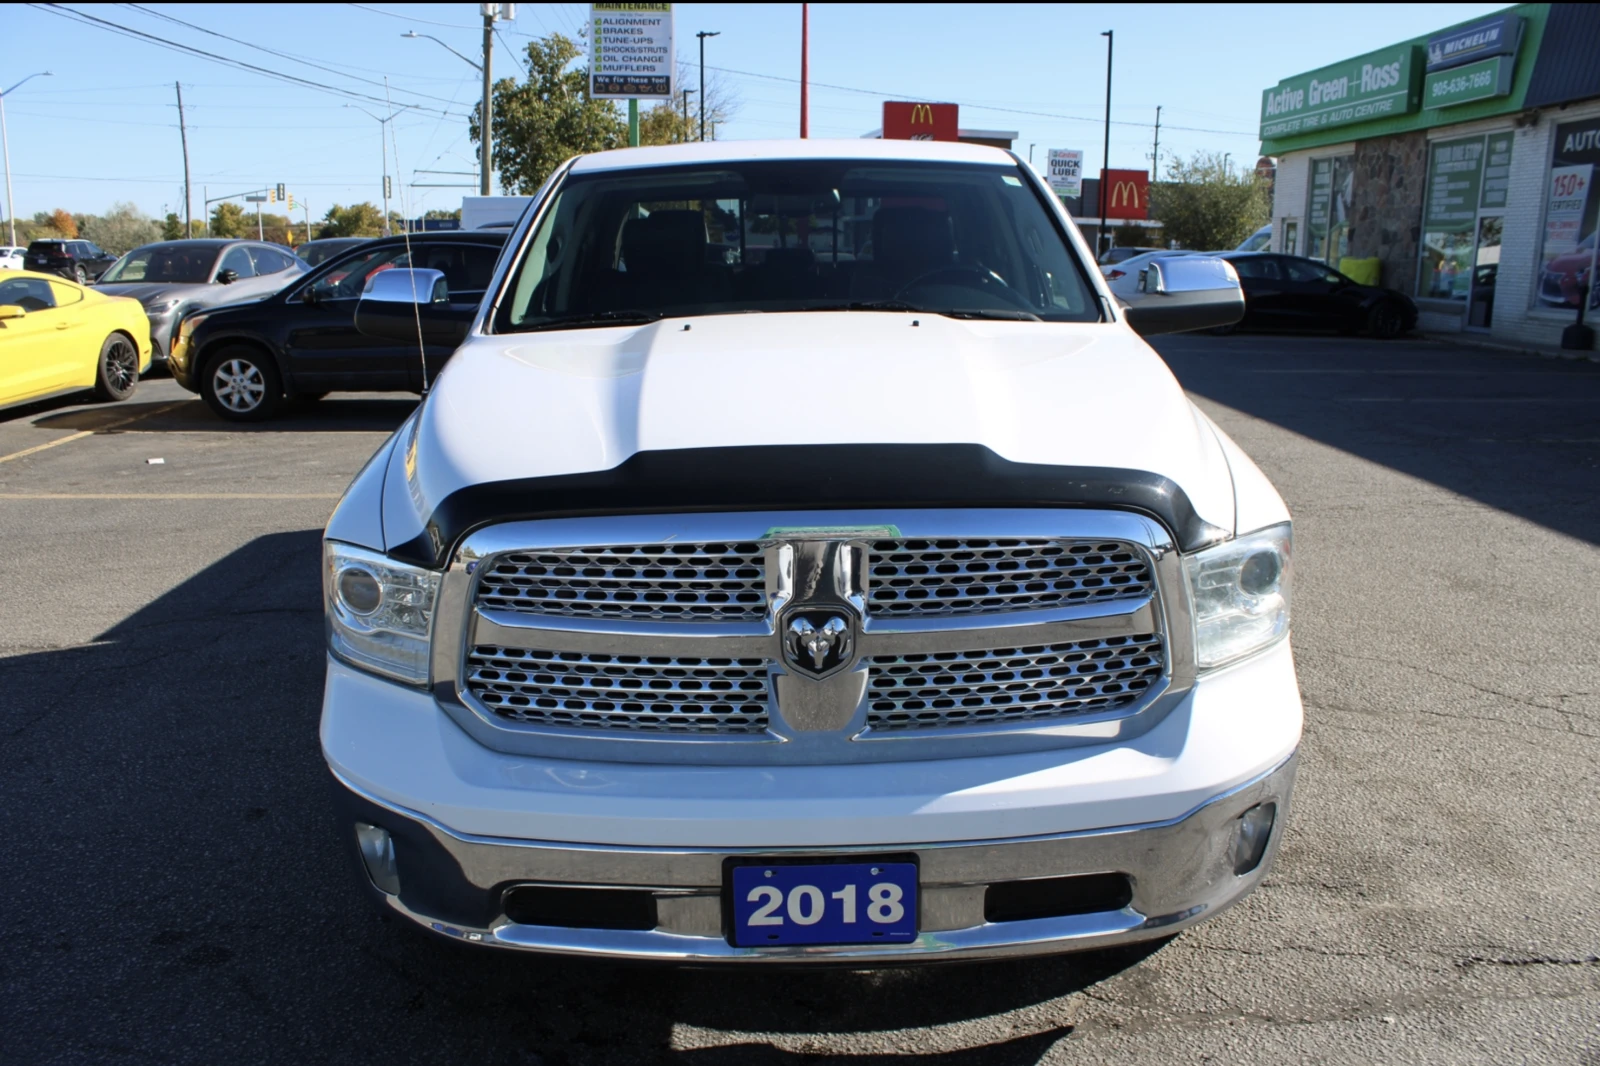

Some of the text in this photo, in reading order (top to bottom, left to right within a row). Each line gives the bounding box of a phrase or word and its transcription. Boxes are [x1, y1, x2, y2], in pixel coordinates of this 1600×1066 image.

[1443, 27, 1500, 55] MICHELIN
[602, 46, 668, 54] SHOCKS/STRUTS
[621, 55, 664, 63] CHANGE
[627, 76, 649, 84] these
[1265, 87, 1304, 116] Active
[1308, 79, 1349, 106] Green
[1360, 61, 1400, 93] Ross
[1263, 120, 1301, 136] COMPLETE
[1302, 114, 1320, 128] TIRE
[1329, 107, 1353, 123] AUTO
[1354, 99, 1394, 118] CENTRE
[1050, 159, 1080, 168] QUICK
[1052, 168, 1077, 177] LUBE
[1554, 173, 1585, 197] 150+
[746, 882, 905, 926] 2018
